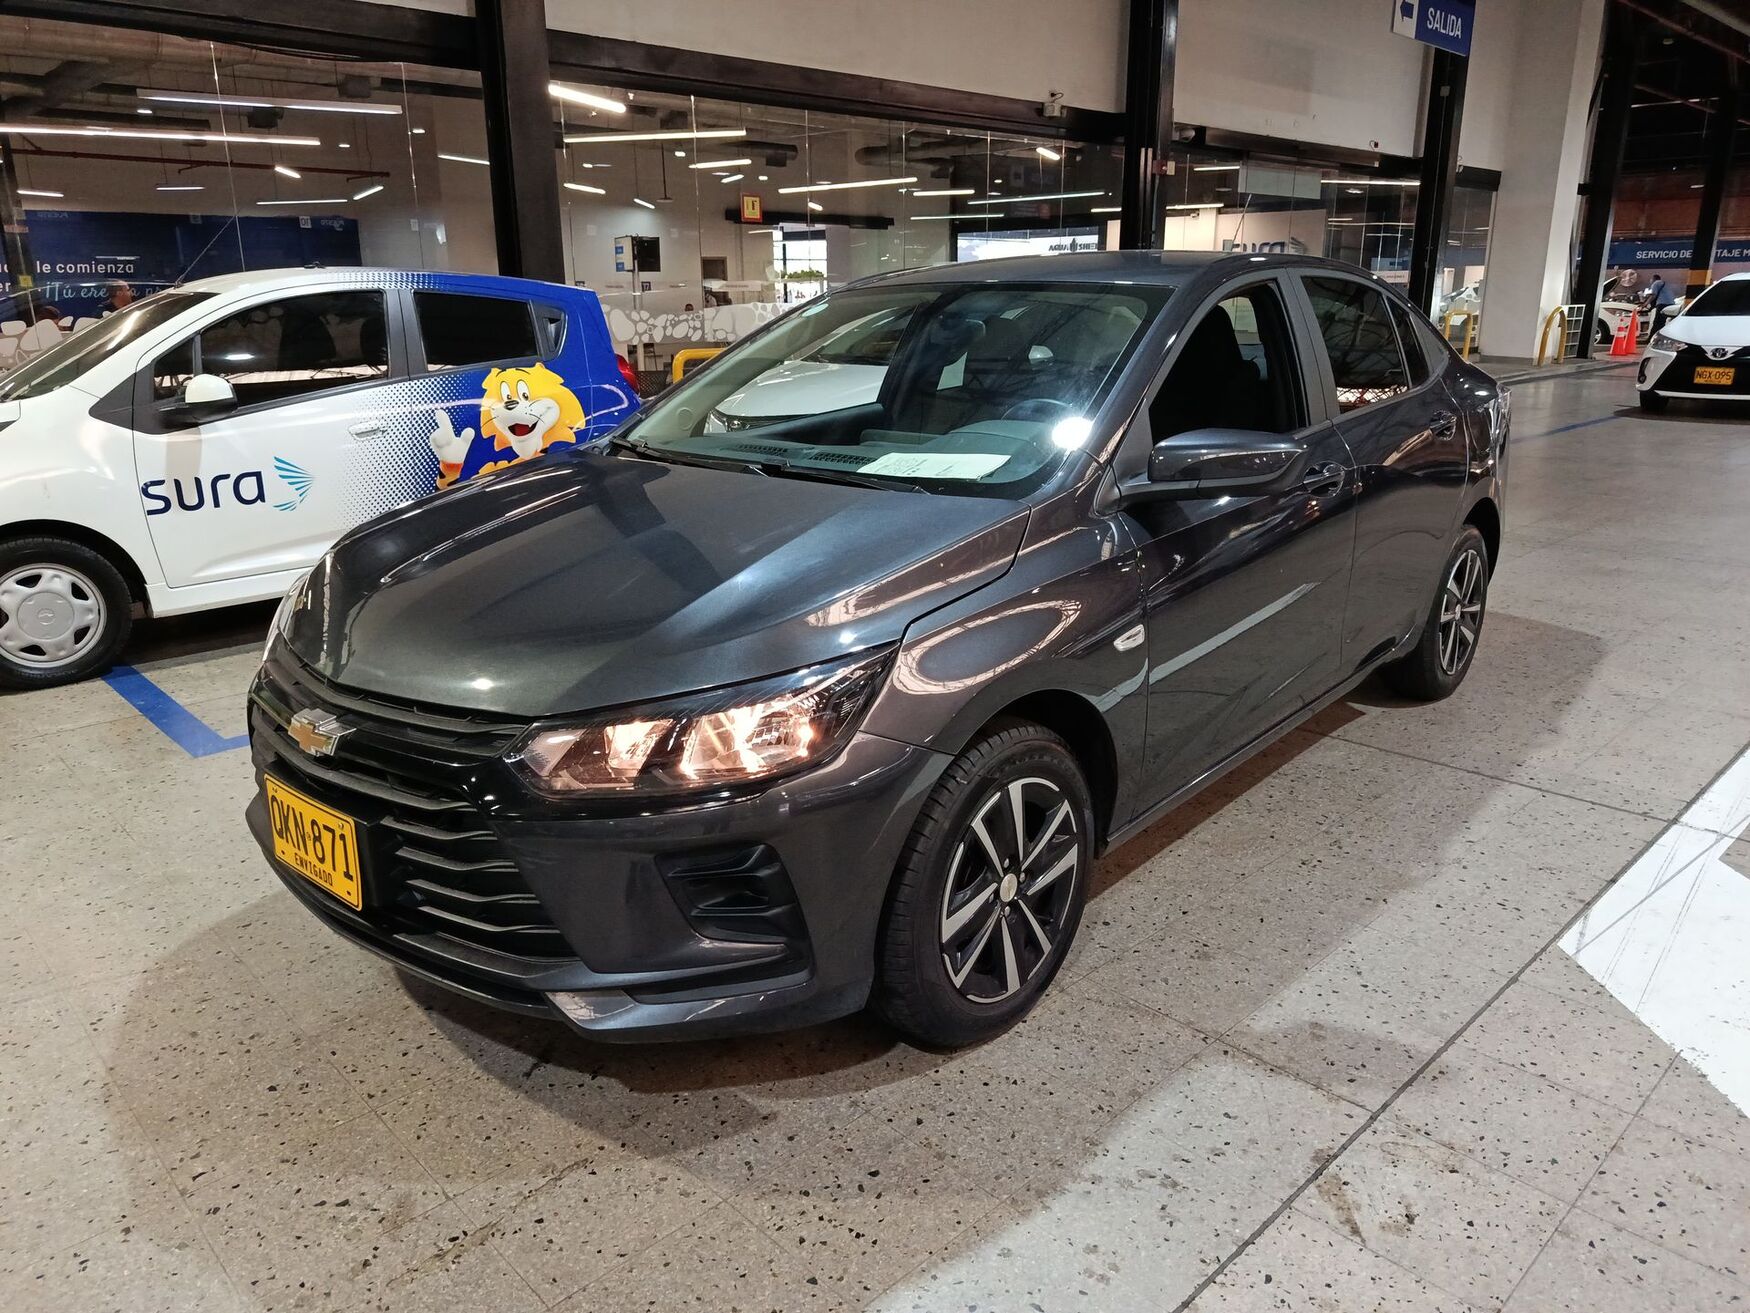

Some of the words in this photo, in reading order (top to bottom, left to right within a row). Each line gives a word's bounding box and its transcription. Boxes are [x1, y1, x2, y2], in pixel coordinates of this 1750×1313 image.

[1427, 7, 1462, 39] SALIDA
[1635, 250, 1679, 259] SERVICIO
[1679, 249, 1693, 258] DE
[1717, 249, 1741, 257] TAJE
[56, 260, 134, 274] comienza
[80, 286, 109, 298] ere
[141, 470, 266, 516] sura
[294, 852, 334, 887] ENVIGADO
